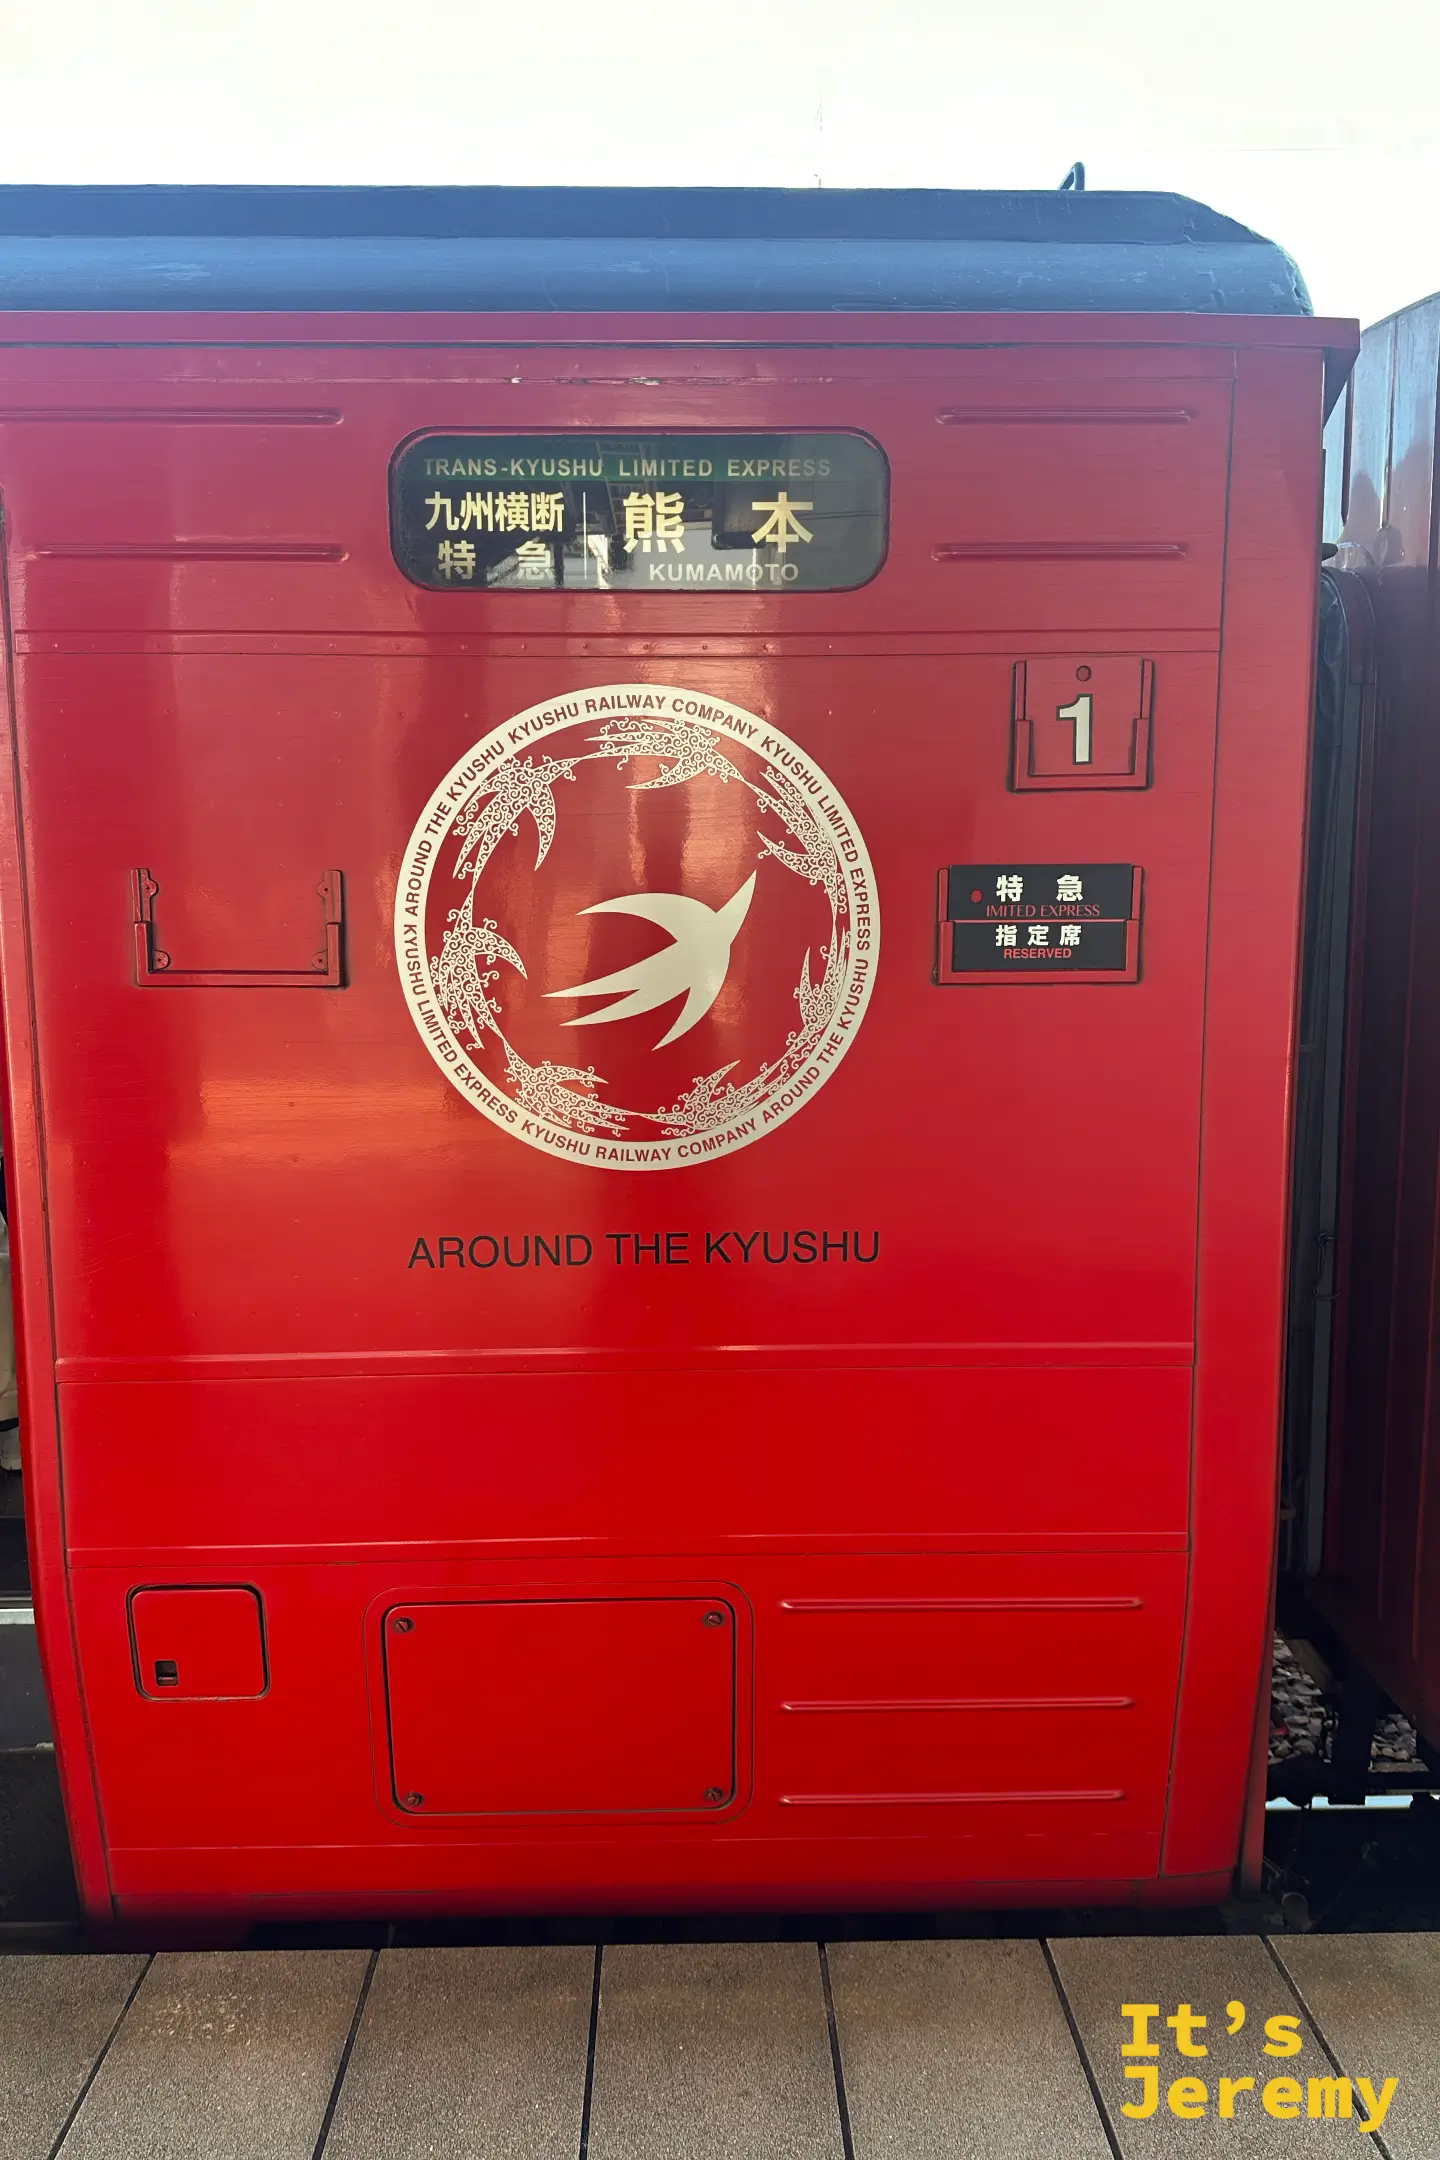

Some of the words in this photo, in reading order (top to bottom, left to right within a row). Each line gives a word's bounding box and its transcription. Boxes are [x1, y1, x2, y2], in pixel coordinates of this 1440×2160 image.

[424, 458, 604, 477] TRANS-KYUSHU
[618, 458, 713, 477] LIMITED
[727, 458, 832, 477] EXPRESS
[424, 491, 566, 532] 九州横断
[623, 490, 815, 554] 熊本
[437, 540, 554, 581] 特急
[649, 563, 800, 582] KUMAMOTO
[1056, 694, 1093, 764] 1
[405, 840, 433, 917] AROUND
[424, 801, 453, 835] THE
[446, 740, 505, 802] KYUSHU
[507, 702, 579, 745] KYUSHU
[584, 694, 666, 714] RAILWAY
[671, 698, 759, 739] COMPANY
[760, 735, 823, 796] KYUSHU
[817, 795, 859, 863] LIMITED
[849, 867, 871, 950] EXPRESS
[996, 874, 1084, 902] 特急
[1040, 904, 1100, 917] EXPRESS
[995, 924, 1082, 947] 指定席
[1003, 948, 1072, 959] RESERVED
[403, 923, 427, 996] KYUSHU
[417, 999, 458, 1063] LIMITED
[453, 1063, 519, 1124] EXPRESS
[521, 1119, 591, 1156] KYUSHU
[595, 1145, 671, 1162] RAILWAY
[677, 1118, 757, 1158] COMPANY
[762, 1066, 821, 1124] AROUND
[816, 1031, 844, 1064] THE
[837, 958, 869, 1031] KYUSHU
[407, 1234, 592, 1268] AROUND
[605, 1232, 690, 1265] THE
[706, 1230, 880, 1264] KYUSHU
